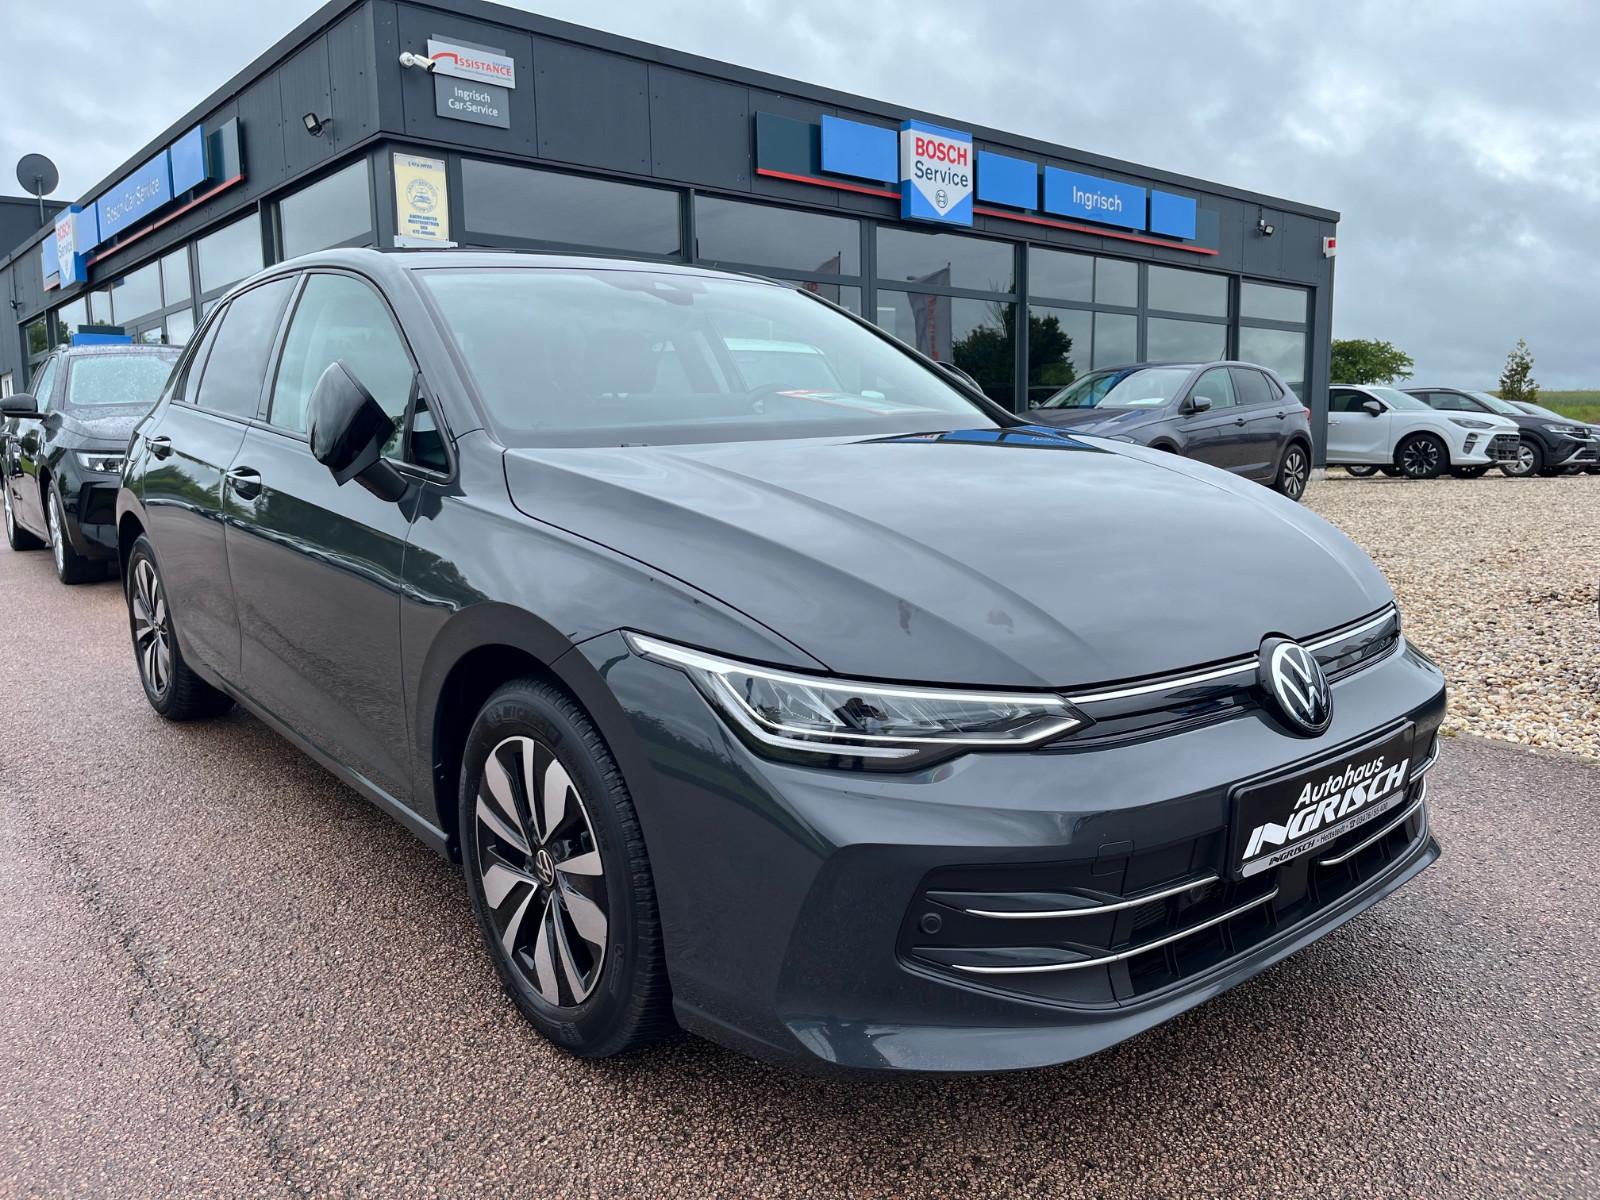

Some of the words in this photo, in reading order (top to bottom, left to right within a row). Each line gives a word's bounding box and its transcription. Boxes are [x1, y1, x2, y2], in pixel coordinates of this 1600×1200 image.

[448, 98, 499, 117] Car-Service
[454, 87, 490, 103] Ingrisch
[915, 137, 968, 166] BOSCH
[914, 161, 969, 187] Service
[1072, 185, 1122, 212] Ingrisch
[1294, 755, 1385, 809] Autohaus
[1242, 758, 1409, 860] INGRISCH
